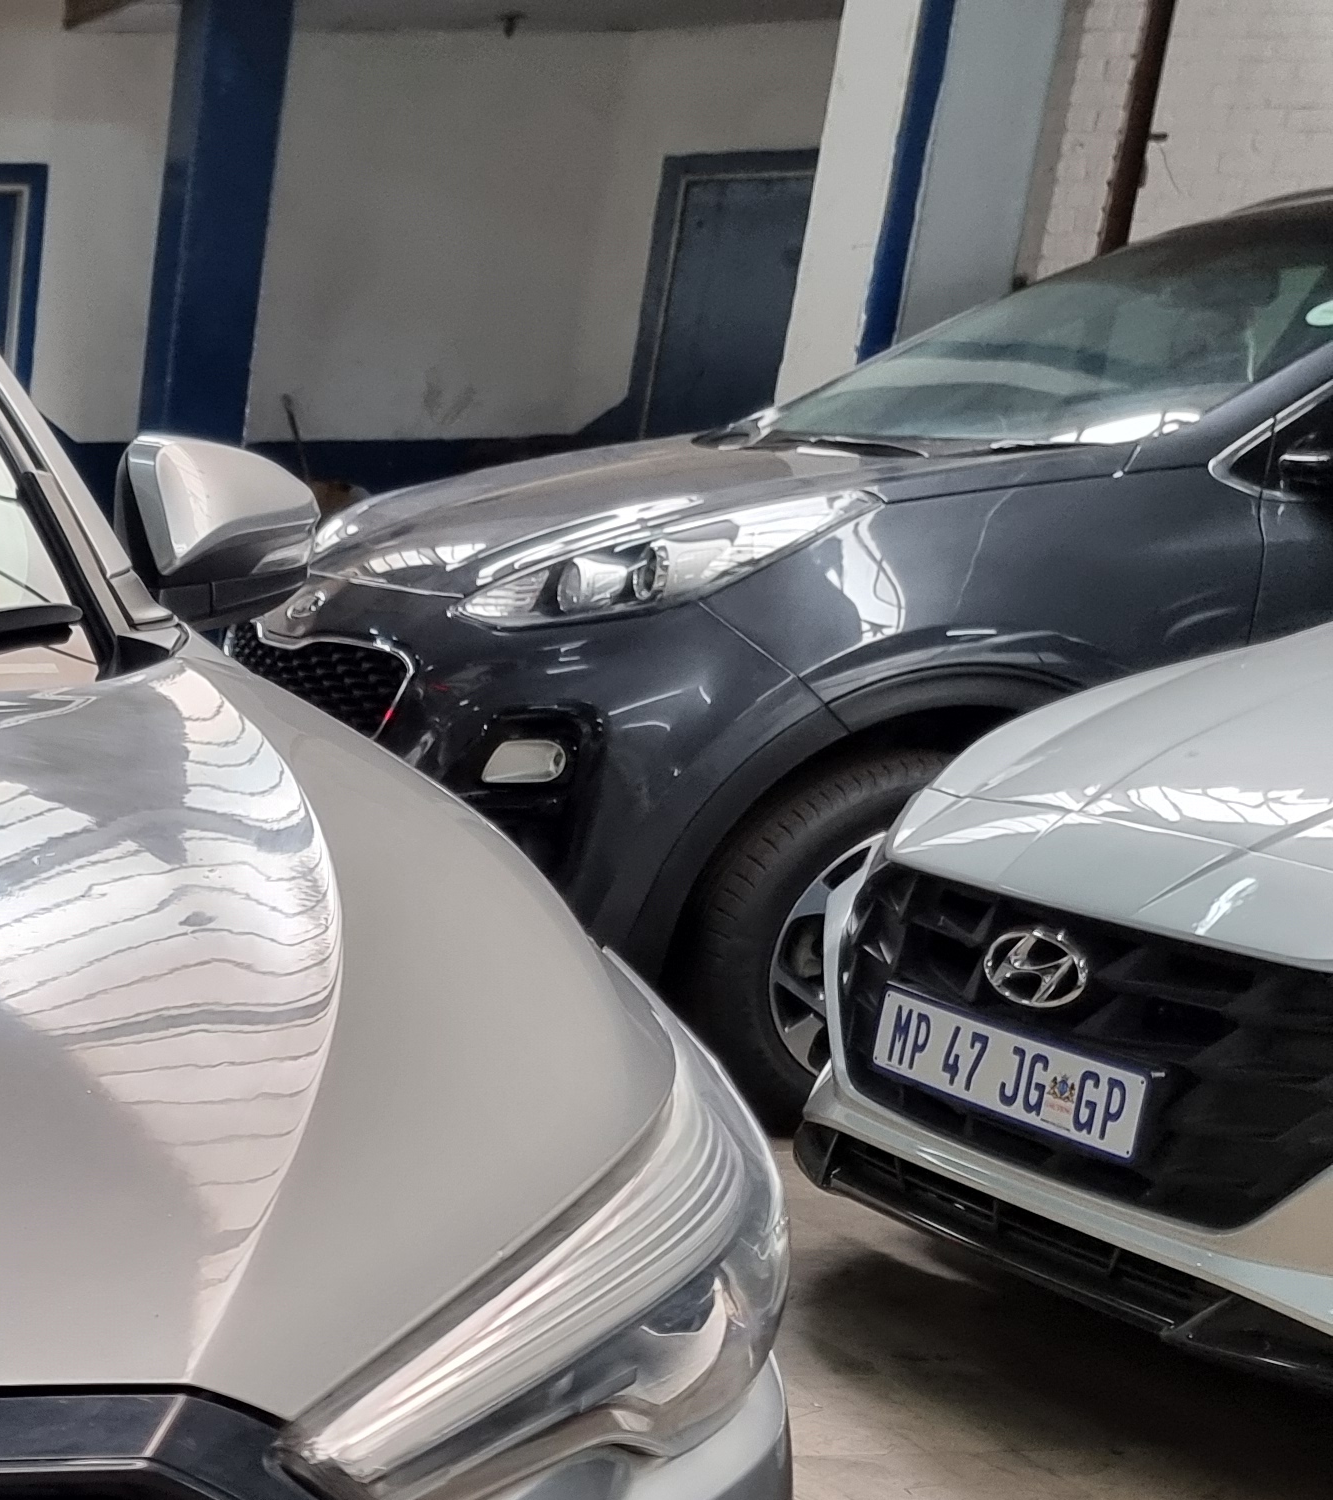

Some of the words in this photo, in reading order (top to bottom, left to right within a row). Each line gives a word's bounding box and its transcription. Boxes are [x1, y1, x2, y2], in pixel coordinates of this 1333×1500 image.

[887, 1004, 931, 1071] MP
[942, 1025, 989, 1092] 47
[999, 1045, 1049, 1117] JG
[1073, 1070, 1127, 1141] GP
